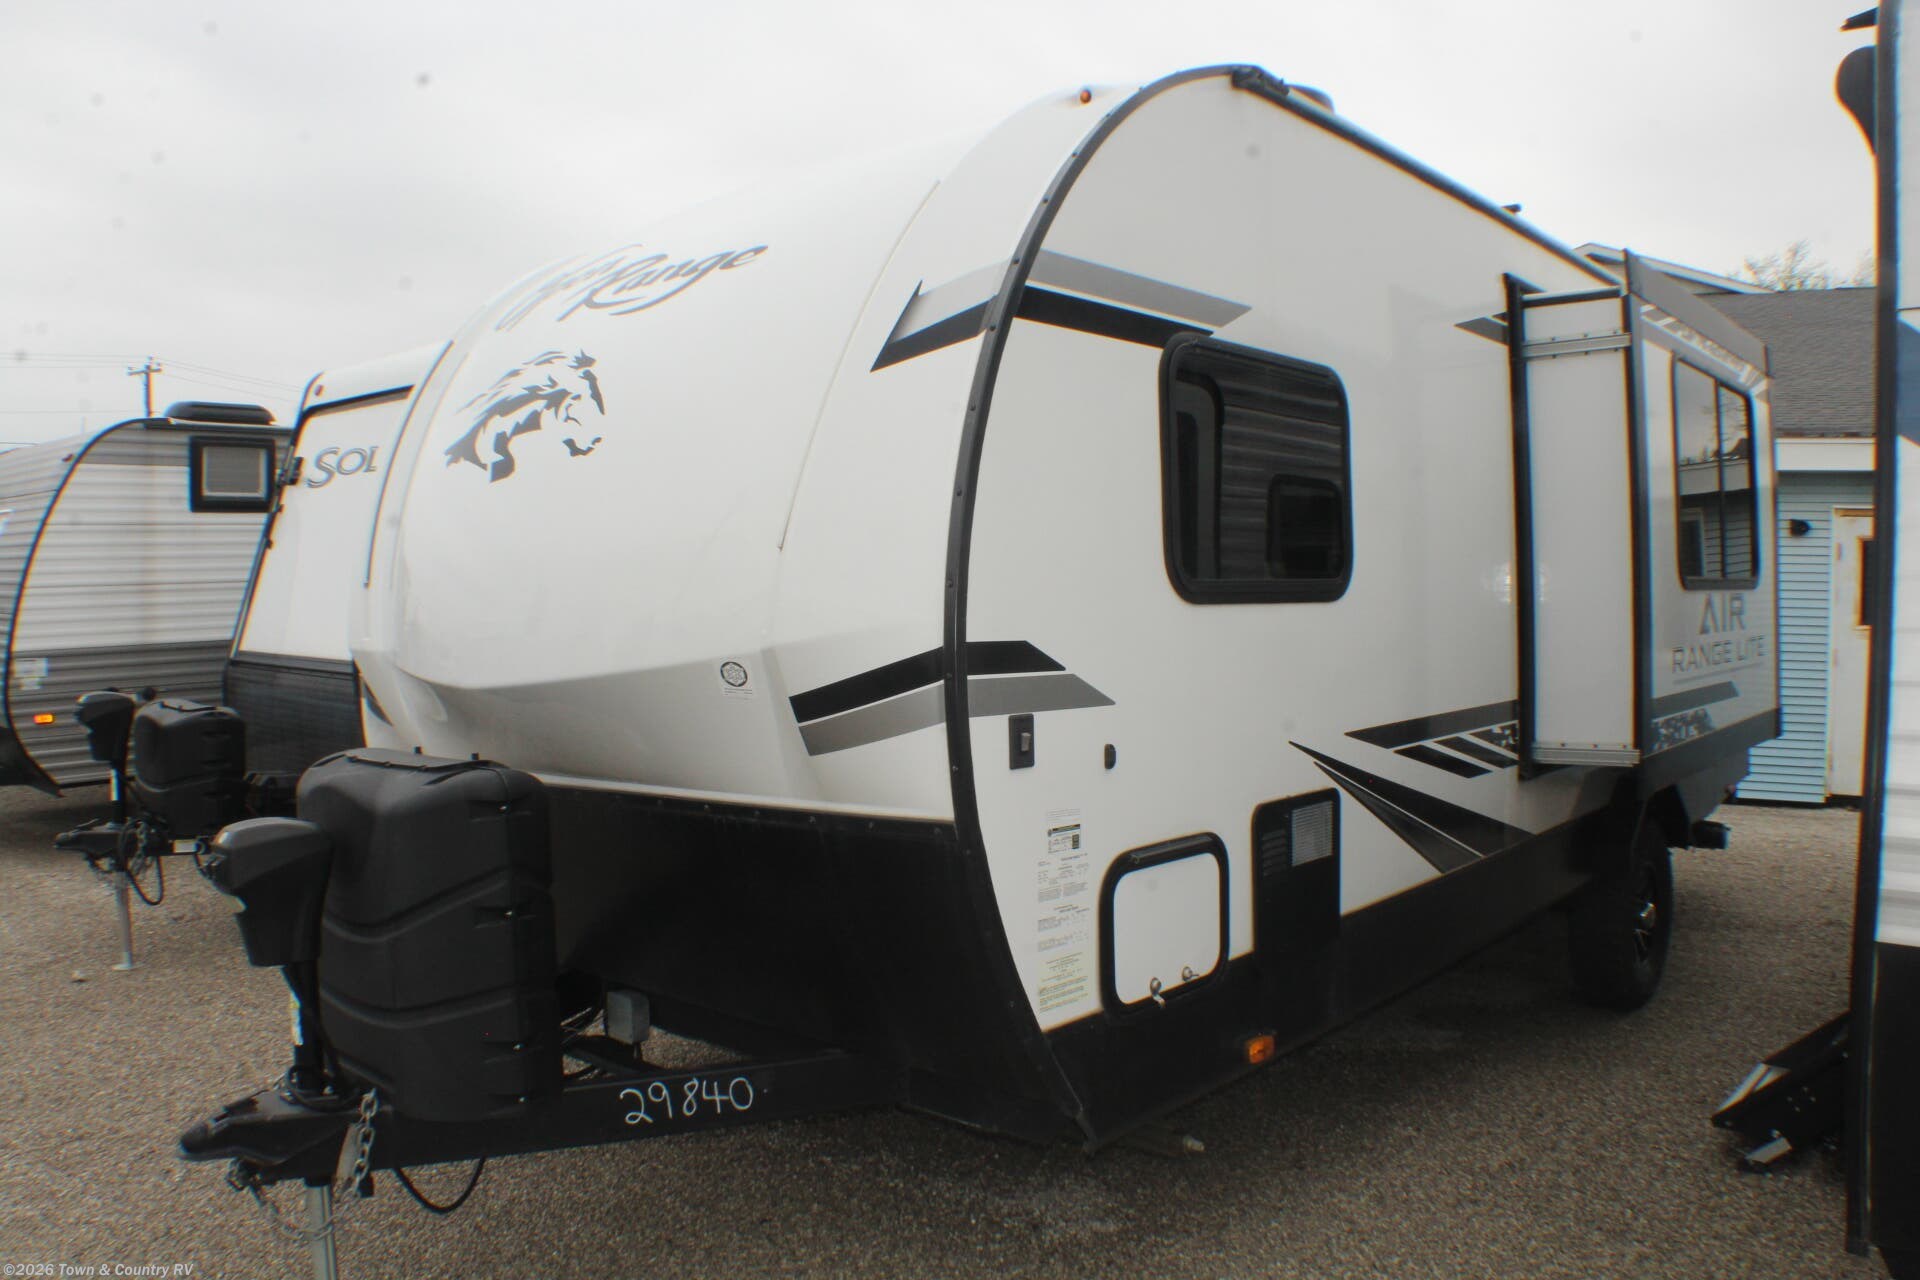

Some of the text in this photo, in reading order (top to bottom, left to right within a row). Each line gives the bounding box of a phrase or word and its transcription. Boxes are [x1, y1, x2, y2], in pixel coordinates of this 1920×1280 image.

[556, 244, 769, 323] Range
[1698, 591, 1747, 635] AIR
[1671, 634, 1766, 674] RANGE LITE
[619, 1076, 754, 1125] 29840
